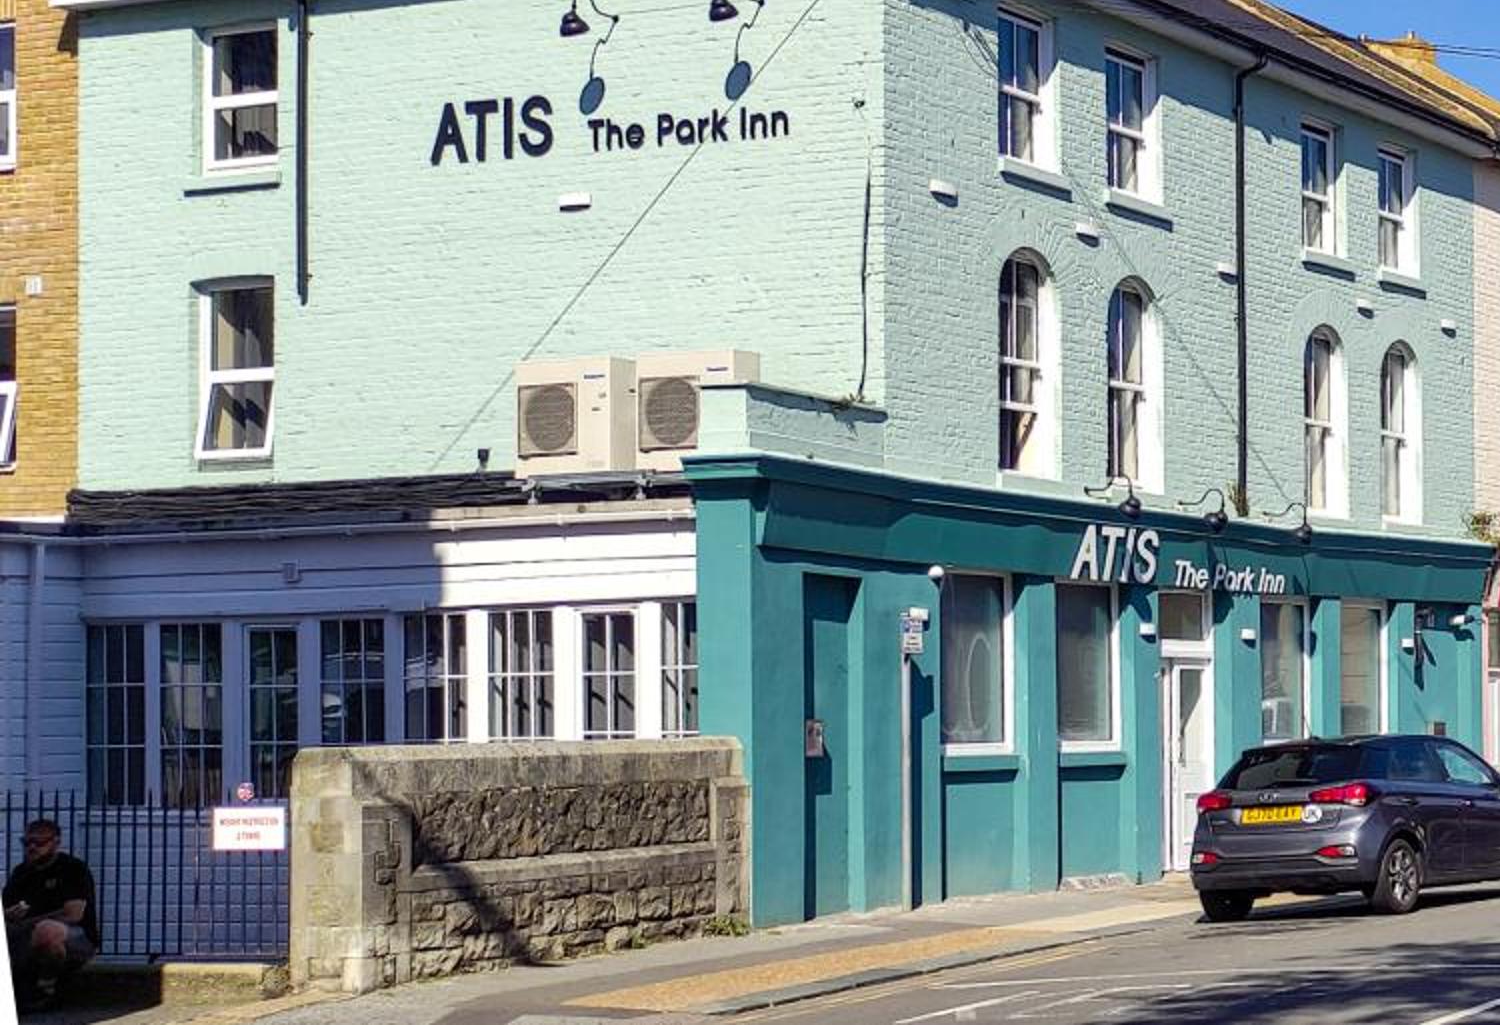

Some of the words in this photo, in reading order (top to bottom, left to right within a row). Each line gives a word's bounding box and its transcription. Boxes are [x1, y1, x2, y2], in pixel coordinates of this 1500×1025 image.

[431, 95, 553, 166] ATIS
[588, 118, 645, 152] The
[657, 109, 728, 147] Park
[740, 107, 789, 140] Inn
[1070, 525, 1160, 584] ATIS
[1174, 559, 1209, 589] The
[1213, 563, 1254, 593] Park
[1257, 567, 1286, 594] Inn
